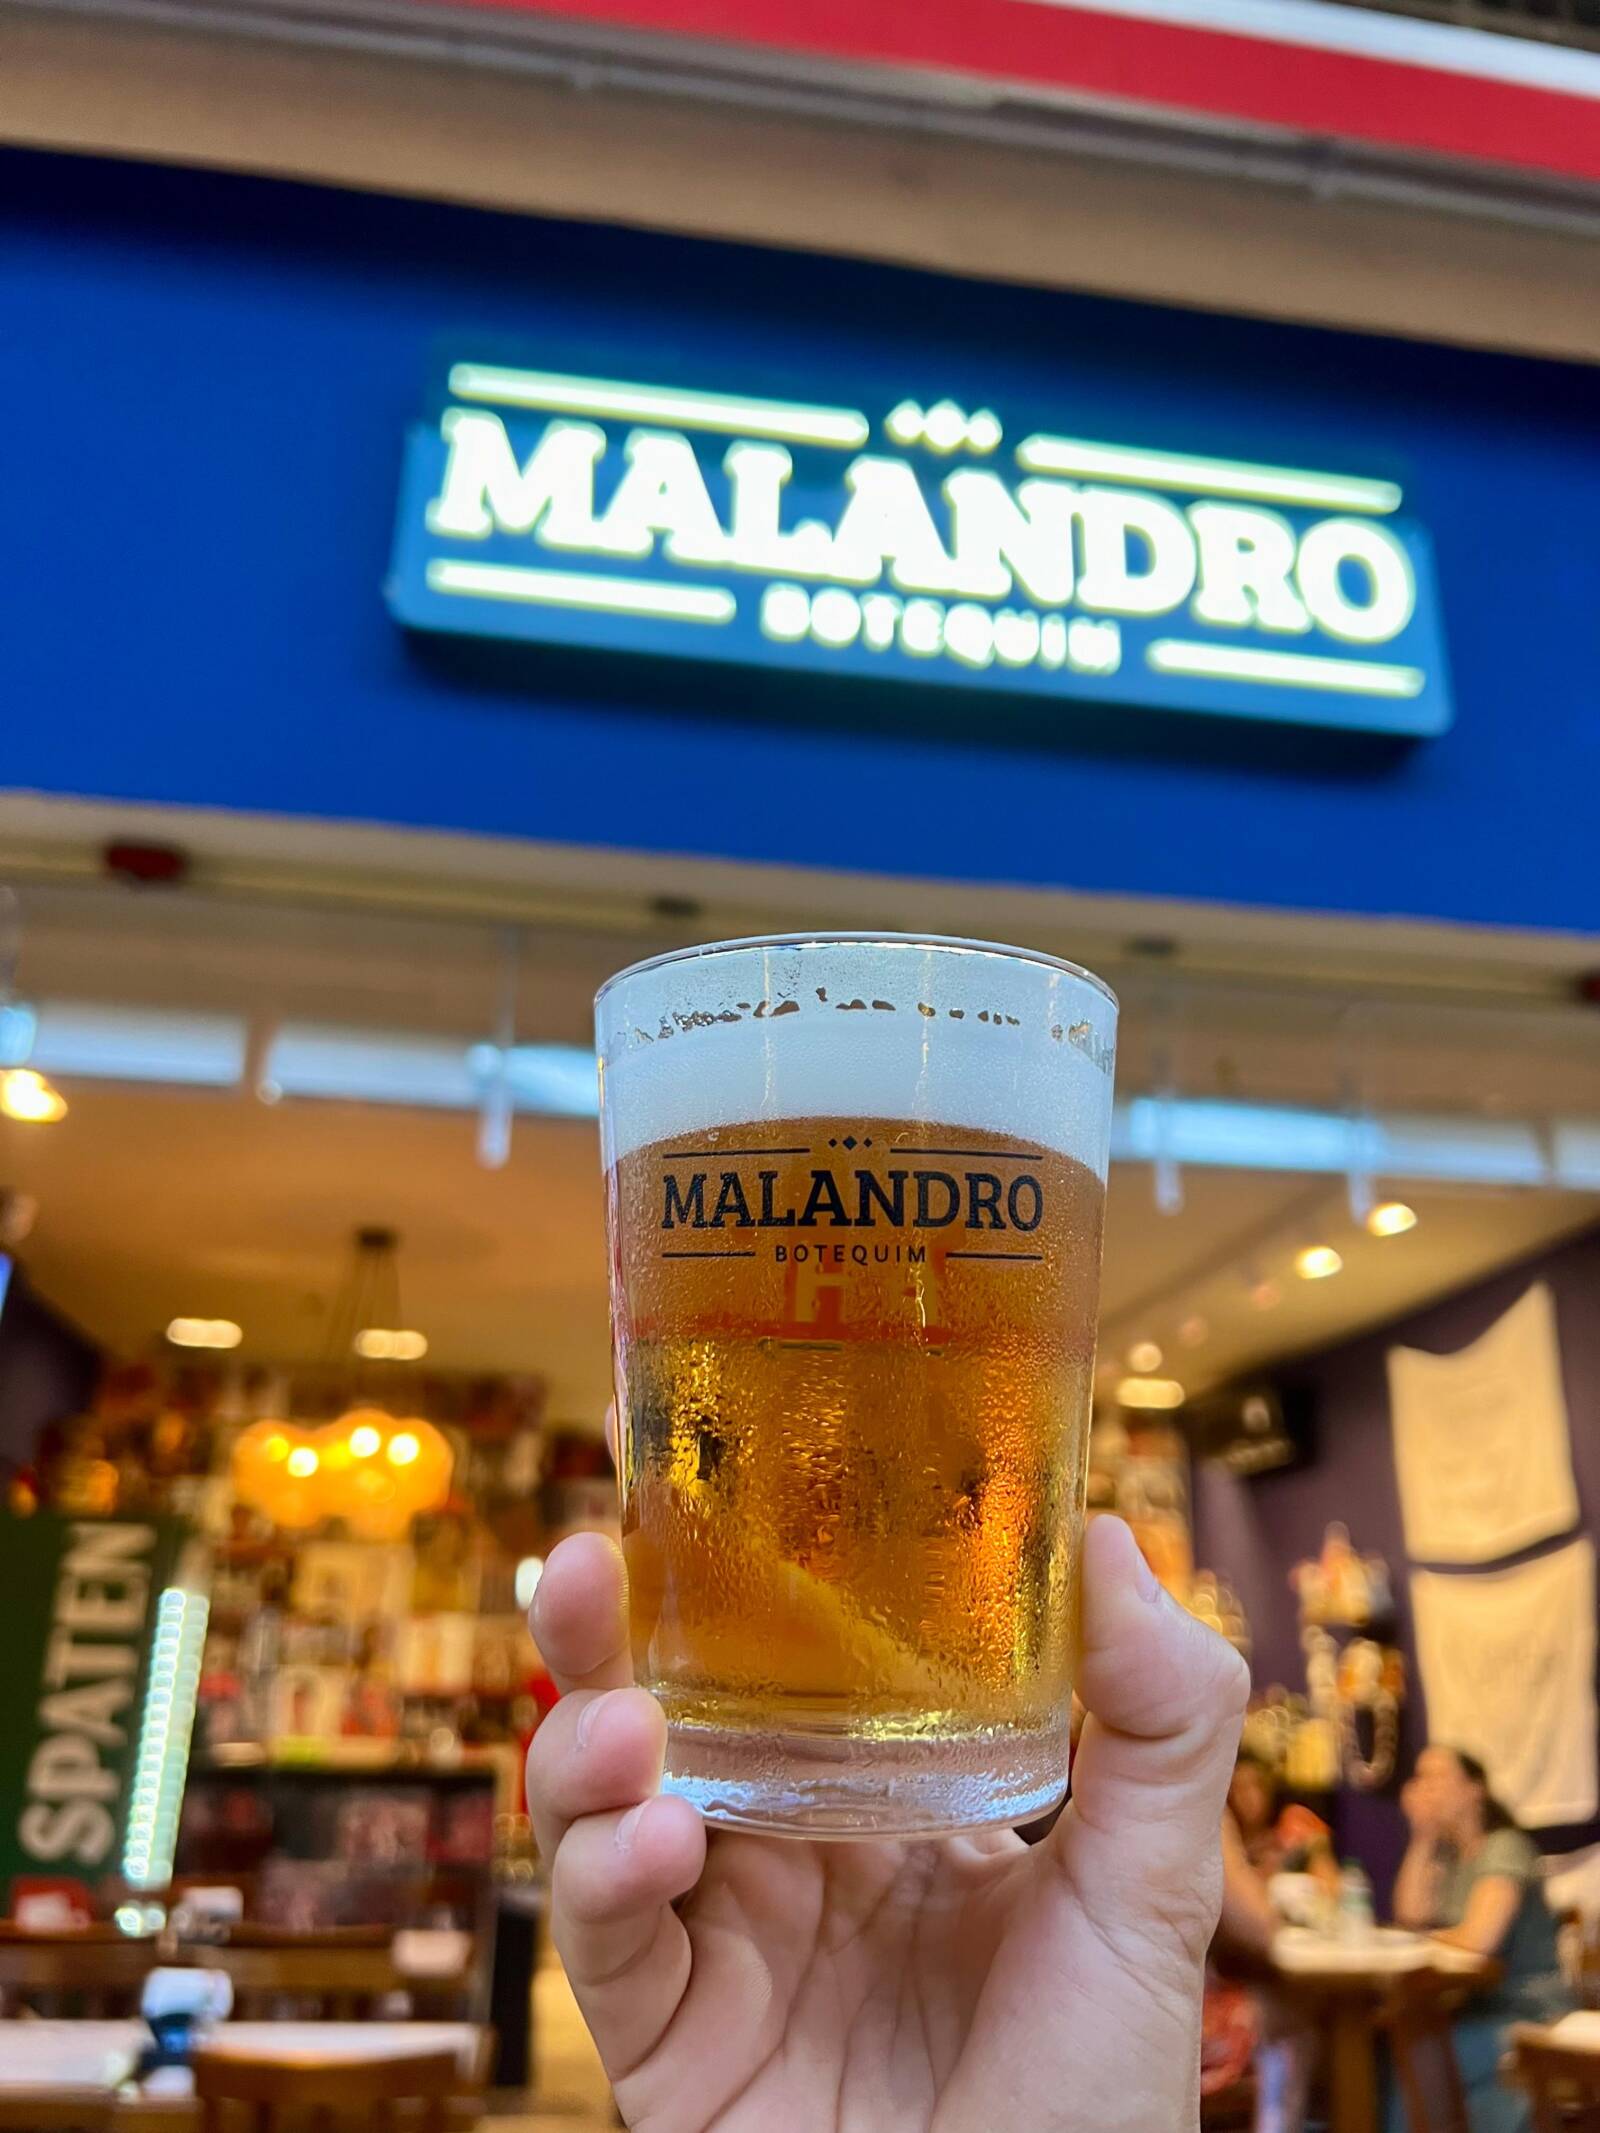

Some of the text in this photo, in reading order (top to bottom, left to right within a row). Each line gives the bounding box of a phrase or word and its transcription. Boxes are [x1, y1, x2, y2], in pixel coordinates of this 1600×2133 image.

[425, 407, 1415, 642] MALANDRO
[661, 1169, 1043, 1231] MALANDRO
[774, 1244, 926, 1265] BOTEQUIM
[18, 1522, 156, 1864] SPATEN
